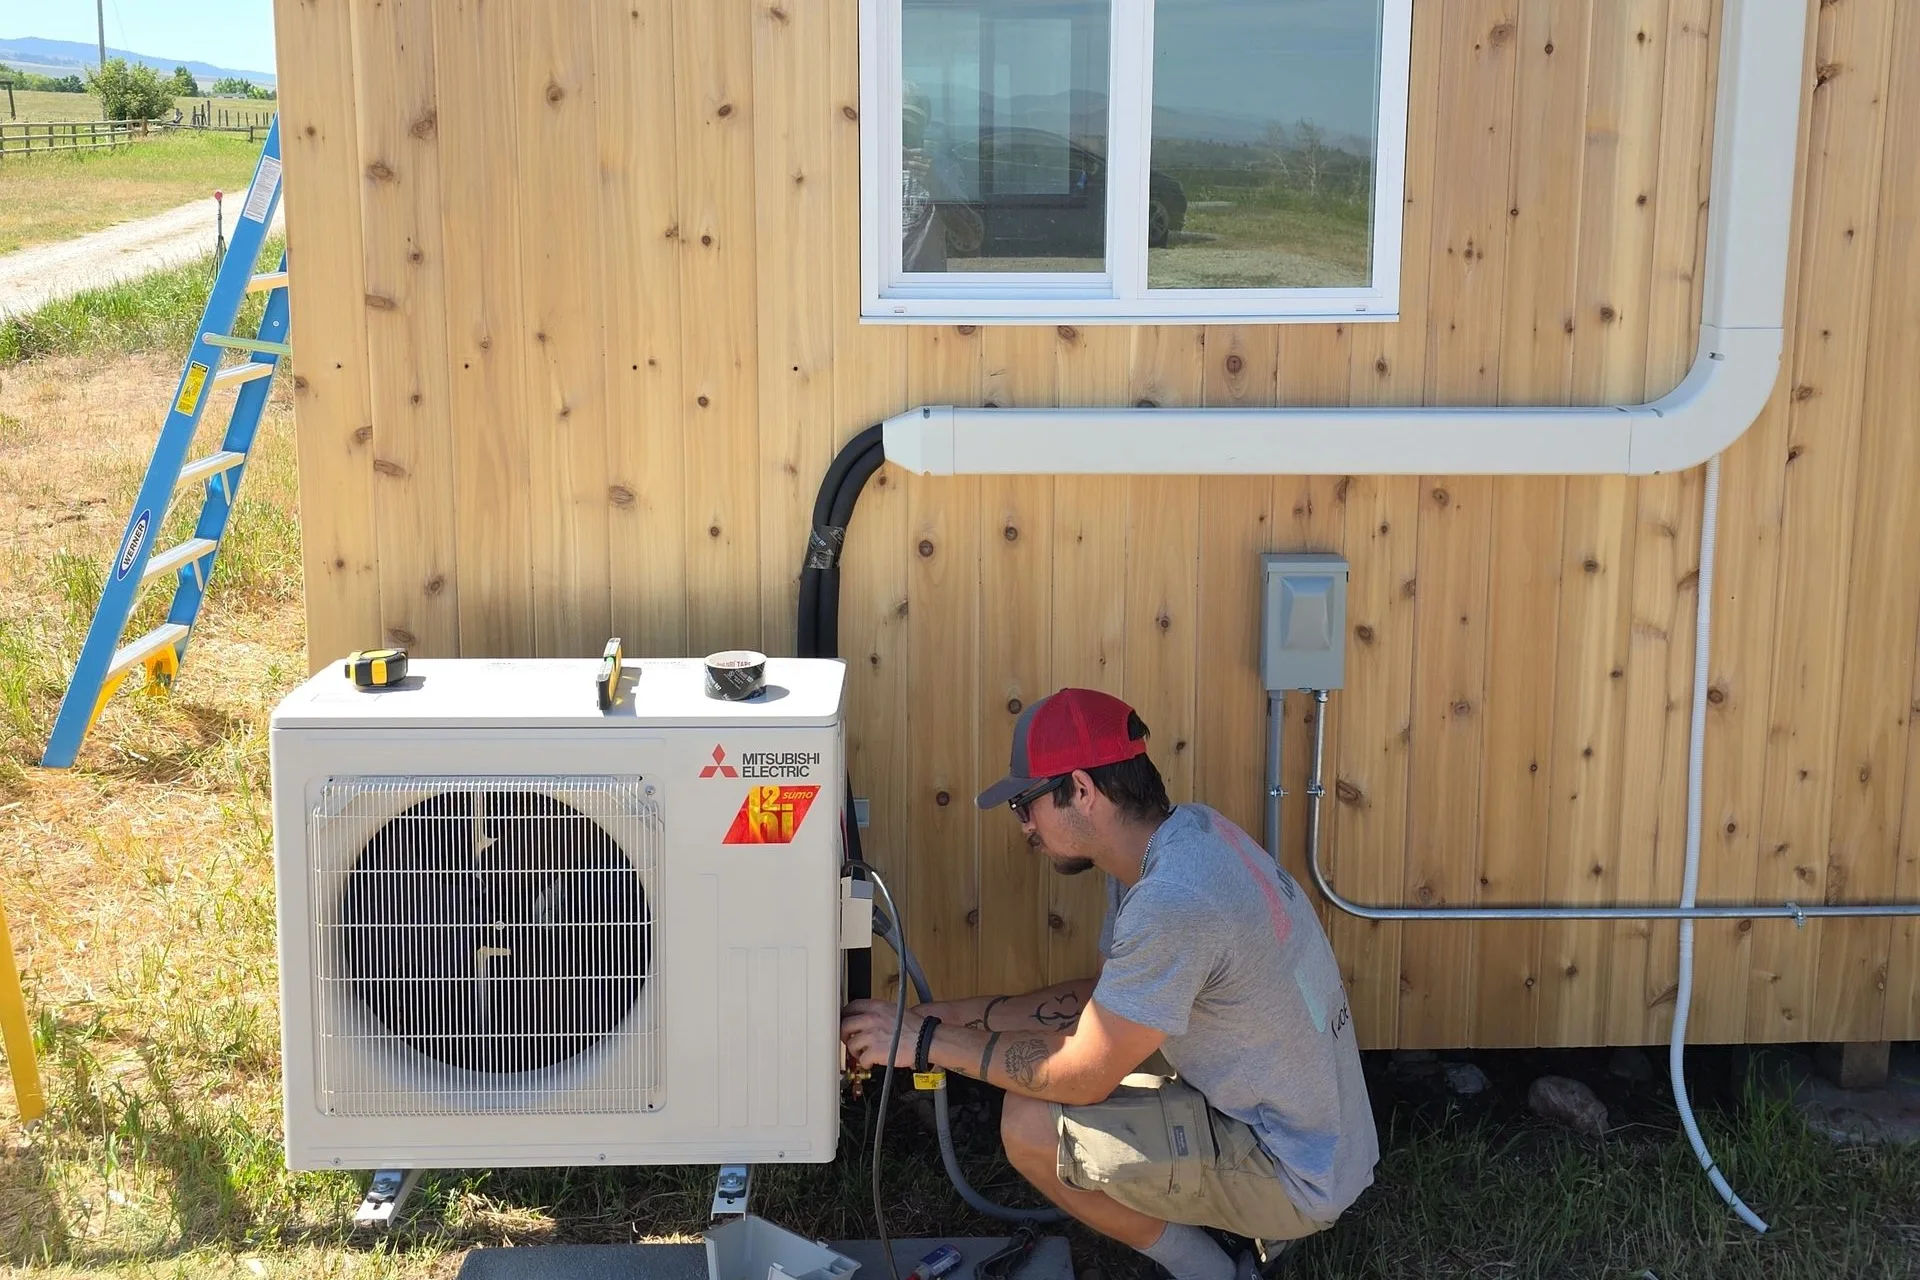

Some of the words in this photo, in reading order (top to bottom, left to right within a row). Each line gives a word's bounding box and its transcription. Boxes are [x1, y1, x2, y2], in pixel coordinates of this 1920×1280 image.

[123, 523, 145, 566] WERNER
[742, 753, 820, 765] MITSUBISHI
[742, 766, 810, 778] ELECTRIC
[782, 790, 814, 799] sumo
